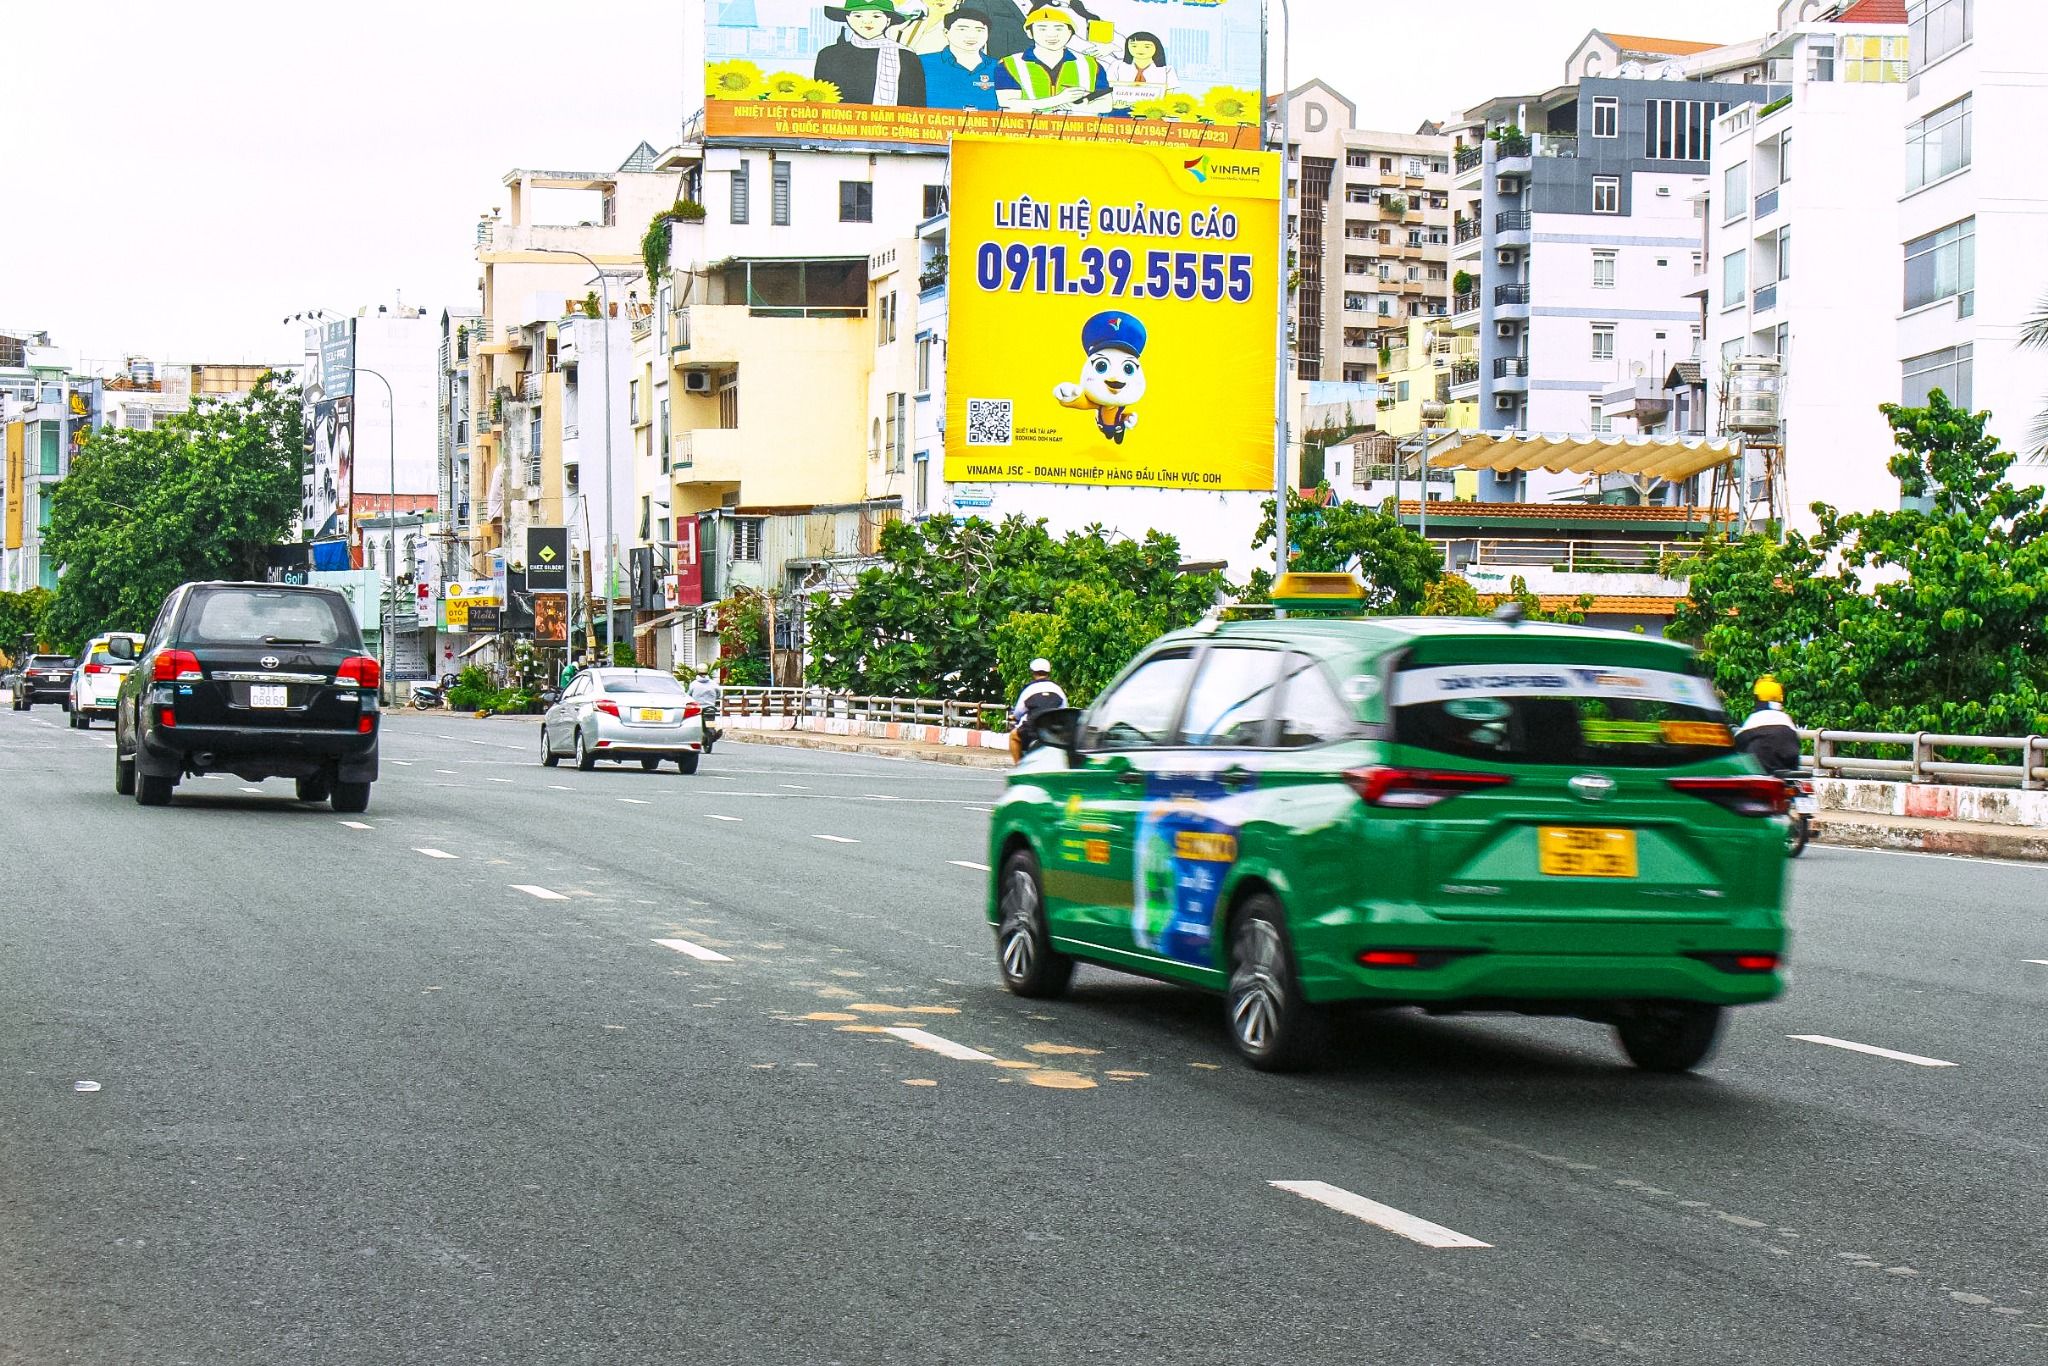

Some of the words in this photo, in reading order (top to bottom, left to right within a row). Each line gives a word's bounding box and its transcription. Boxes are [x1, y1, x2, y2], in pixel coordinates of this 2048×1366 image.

[734, 106, 764, 118] NHIỆT
[767, 107, 788, 119] LIỆT
[791, 106, 818, 119] CHÀO
[822, 108, 852, 121] MỪNG
[856, 110, 868, 121] 78
[870, 108, 895, 122] NĂM
[897, 109, 926, 124] NGÀY
[928, 110, 955, 126] CÁCH
[1087, 119, 1114, 133] CÔNG
[1305, 102, 1328, 132] D
[775, 120, 790, 132] VÀ
[792, 121, 820, 134] QUỐC
[822, 122, 857, 135] KHÁNH
[860, 123, 890, 137] NƯỚC
[892, 125, 920, 139] CỘNG
[922, 127, 944, 140] HÒA
[1211, 165, 1260, 175] VINAMA
[996, 195, 1049, 229] LIÊN
[1060, 198, 1090, 238] HỆ
[1099, 203, 1181, 236] QUẢNG
[1191, 207, 1237, 238] CÁO
[977, 243, 1252, 302] 0911.39.5555
[966, 465, 1003, 475] VINAMA
[1006, 466, 1024, 476] JSC
[1034, 467, 1067, 477] DOANH
[1070, 466, 1104, 481] NGHIỆP
[1107, 467, 1133, 480] HÀNG
[1135, 466, 1155, 481] ĐẦU
[1158, 469, 1179, 482] LĨNH
[1181, 472, 1202, 485] VỰC
[1203, 473, 1221, 483] OOH
[285, 573, 303, 585] Golf
